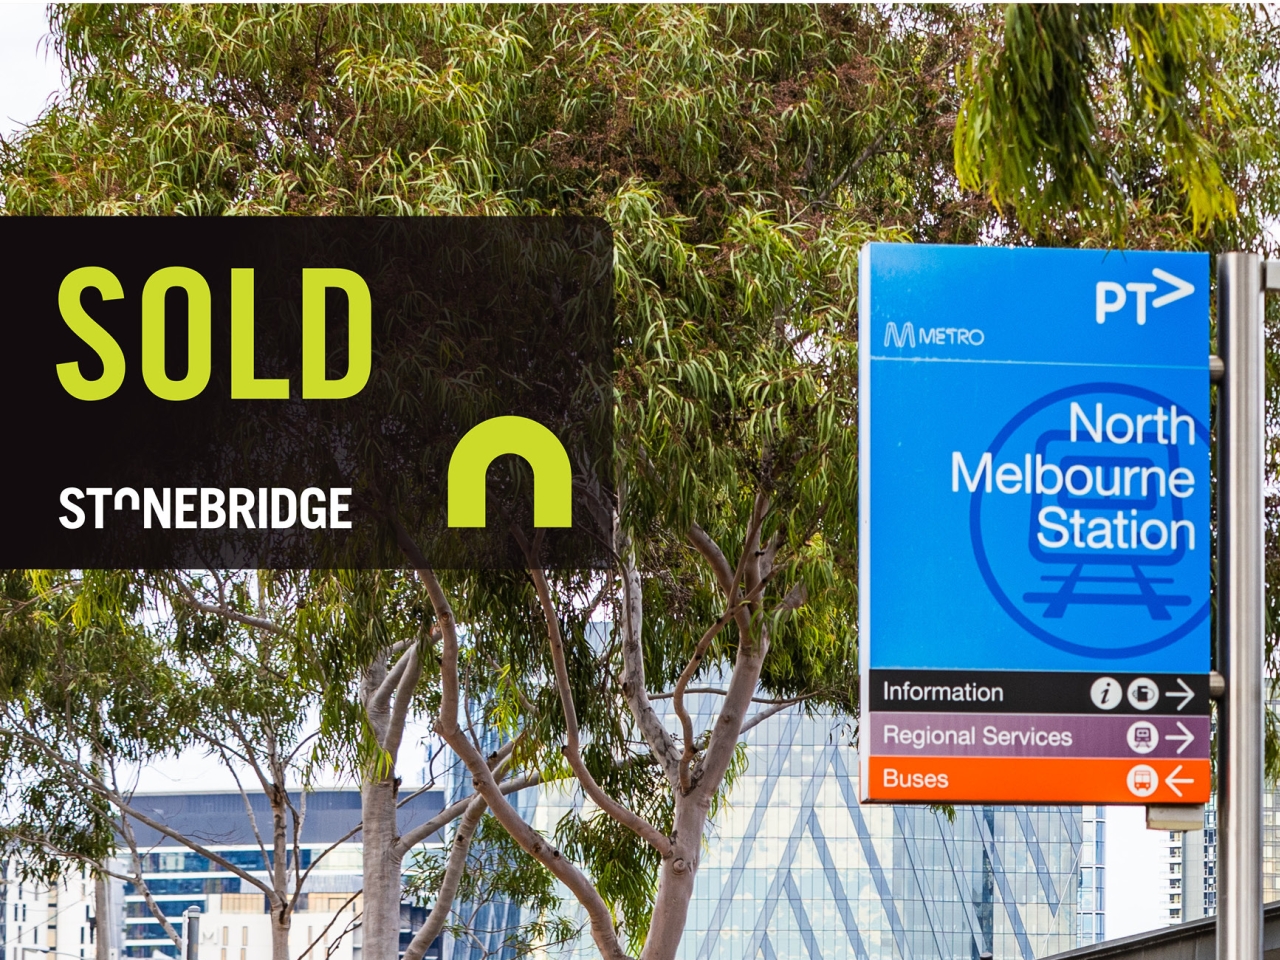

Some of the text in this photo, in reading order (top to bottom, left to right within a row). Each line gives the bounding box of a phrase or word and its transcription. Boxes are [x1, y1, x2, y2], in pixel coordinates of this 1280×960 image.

[918, 327, 985, 346] METRO
[1069, 401, 1196, 446] North
[951, 451, 1196, 498] Melbourne
[1036, 505, 1196, 550] Station
[883, 681, 1004, 703] Information
[883, 724, 1073, 750] Regional Services
[883, 768, 949, 789] Buses
